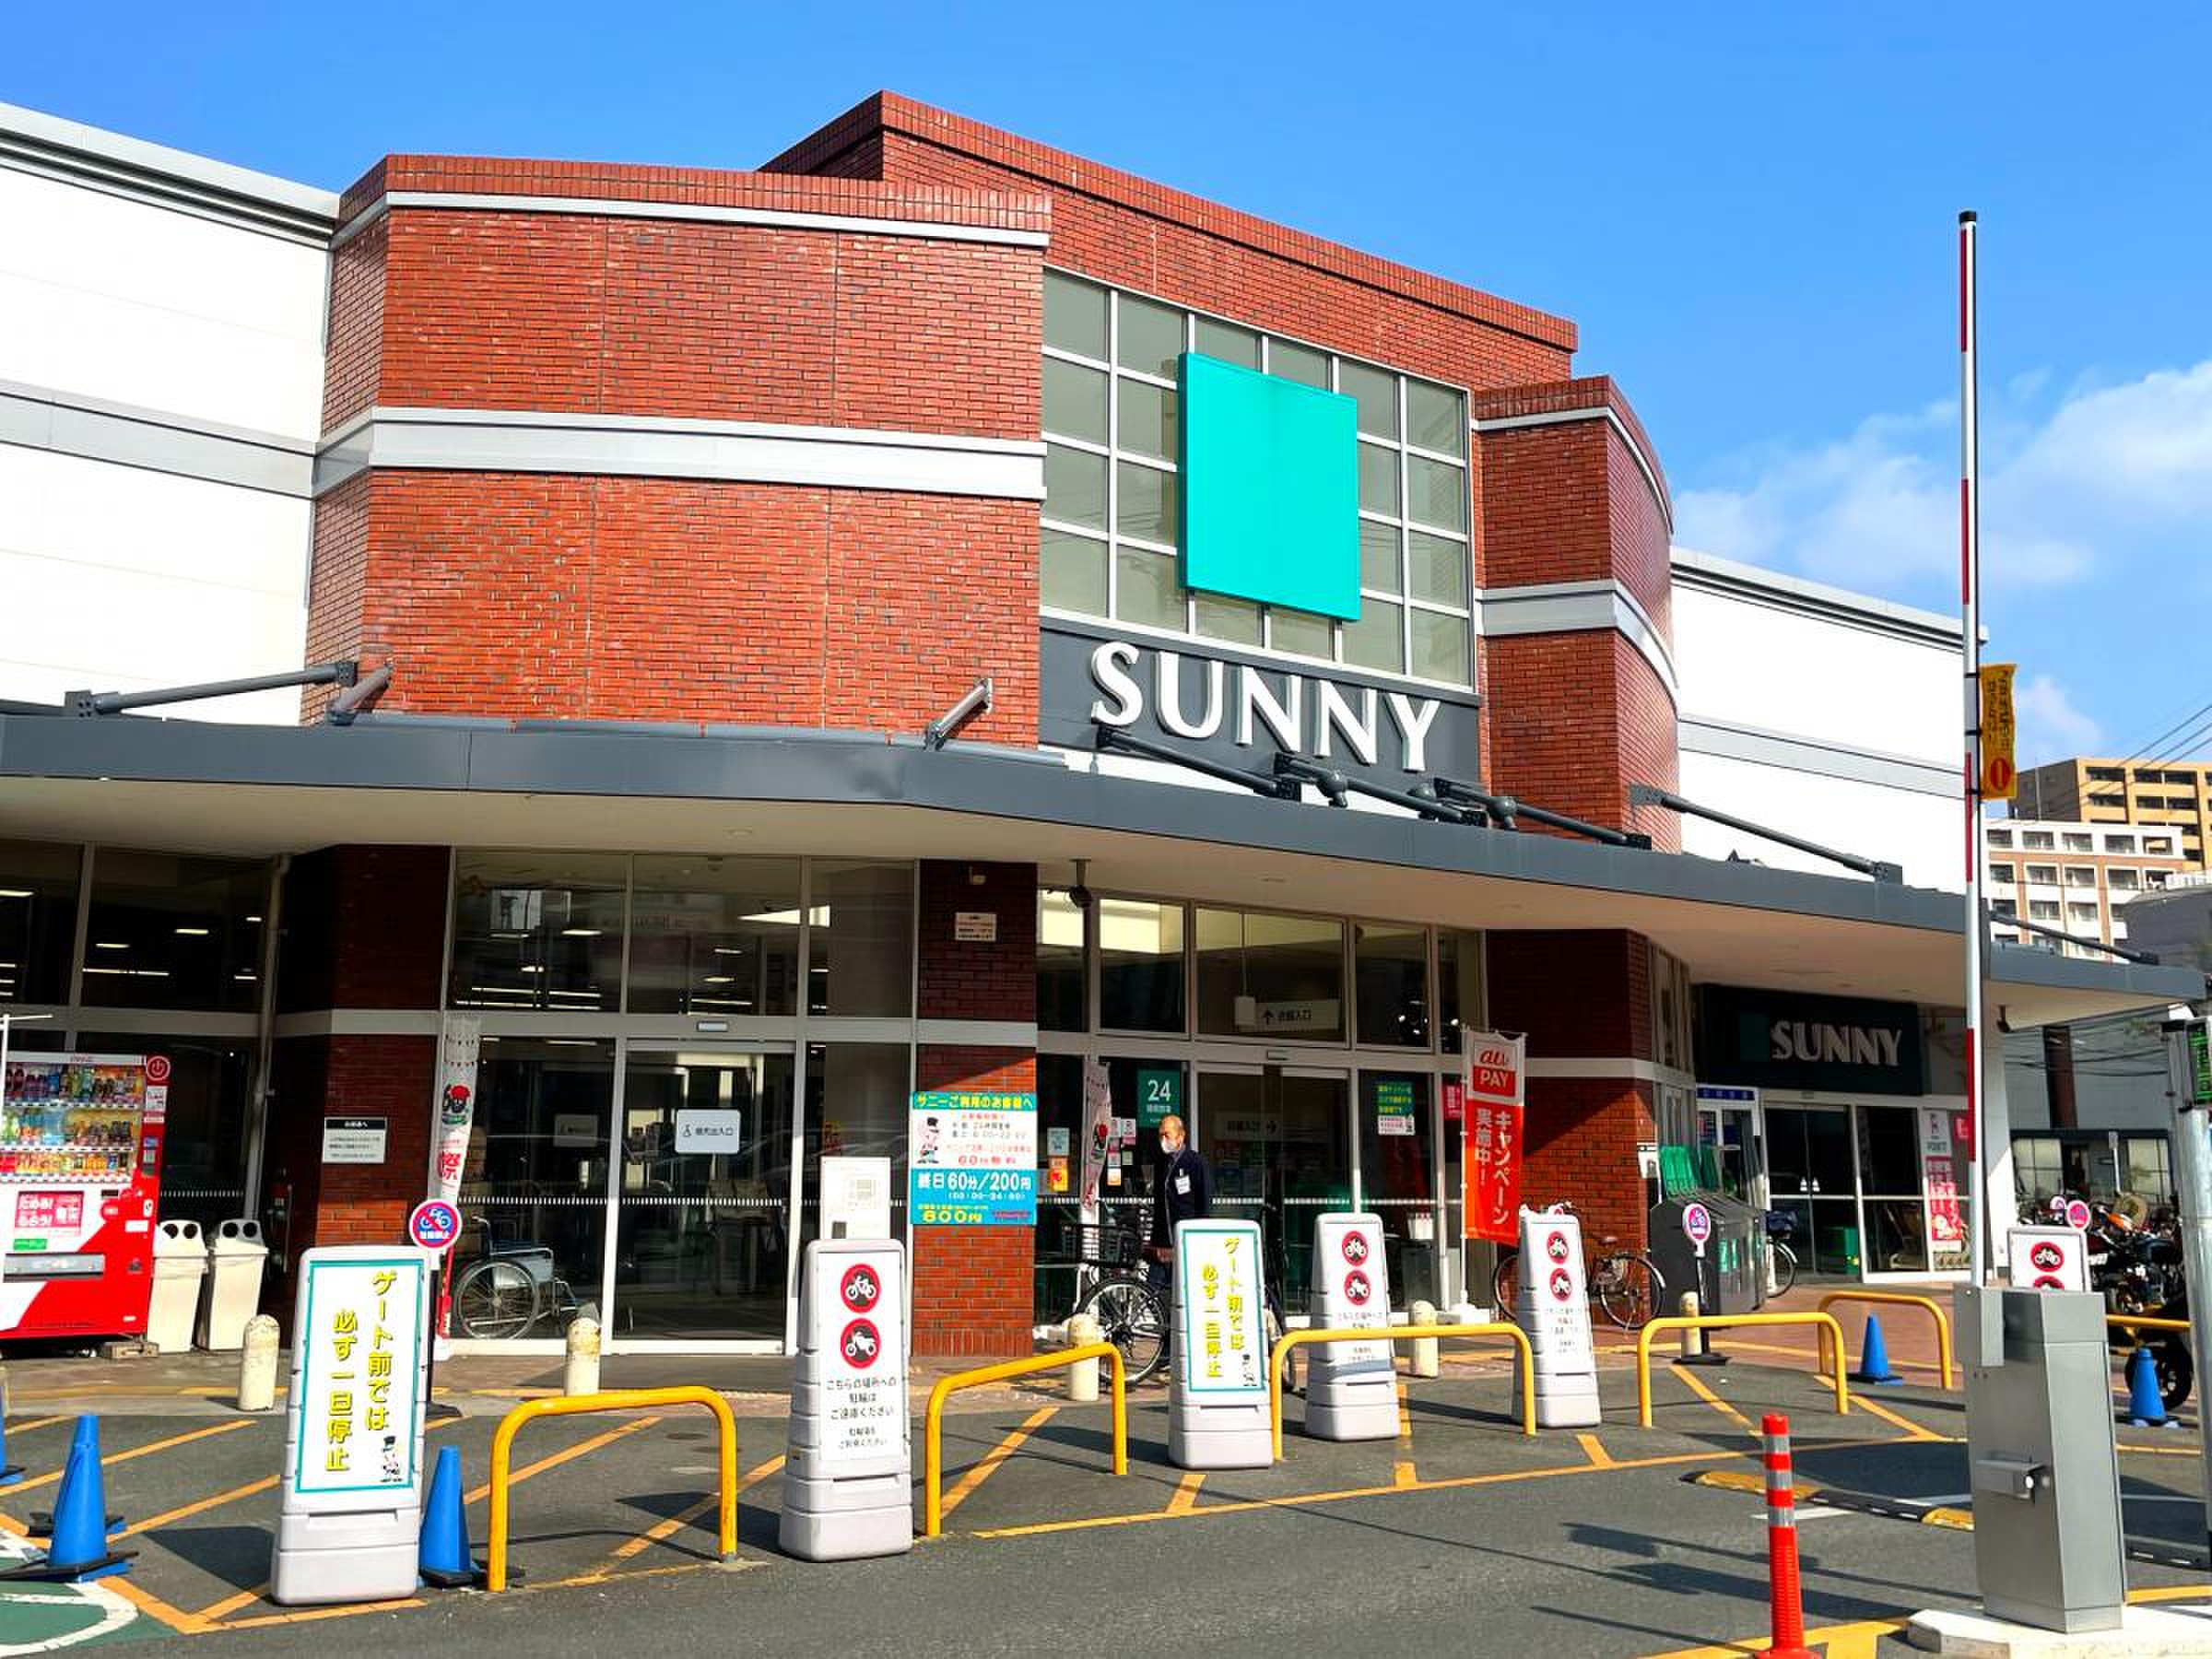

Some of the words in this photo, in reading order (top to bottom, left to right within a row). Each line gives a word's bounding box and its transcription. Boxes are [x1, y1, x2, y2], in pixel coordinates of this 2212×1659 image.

[1090, 641, 1440, 772] SUNNY
[1147, 1078, 1171, 1102] 24
[1480, 1049, 1509, 1066] au
[1480, 1070, 1509, 1088] PAY
[1769, 1019, 1902, 1066] SUNNY
[1492, 1110, 1512, 1225] キャンペーン
[365, 1269, 397, 1431] ゲート前では
[1202, 1263, 1223, 1379] 必ず一旦停止
[1224, 1237, 1244, 1351] ゲート前では
[325, 1308, 358, 1472] 必ず一旦停止
